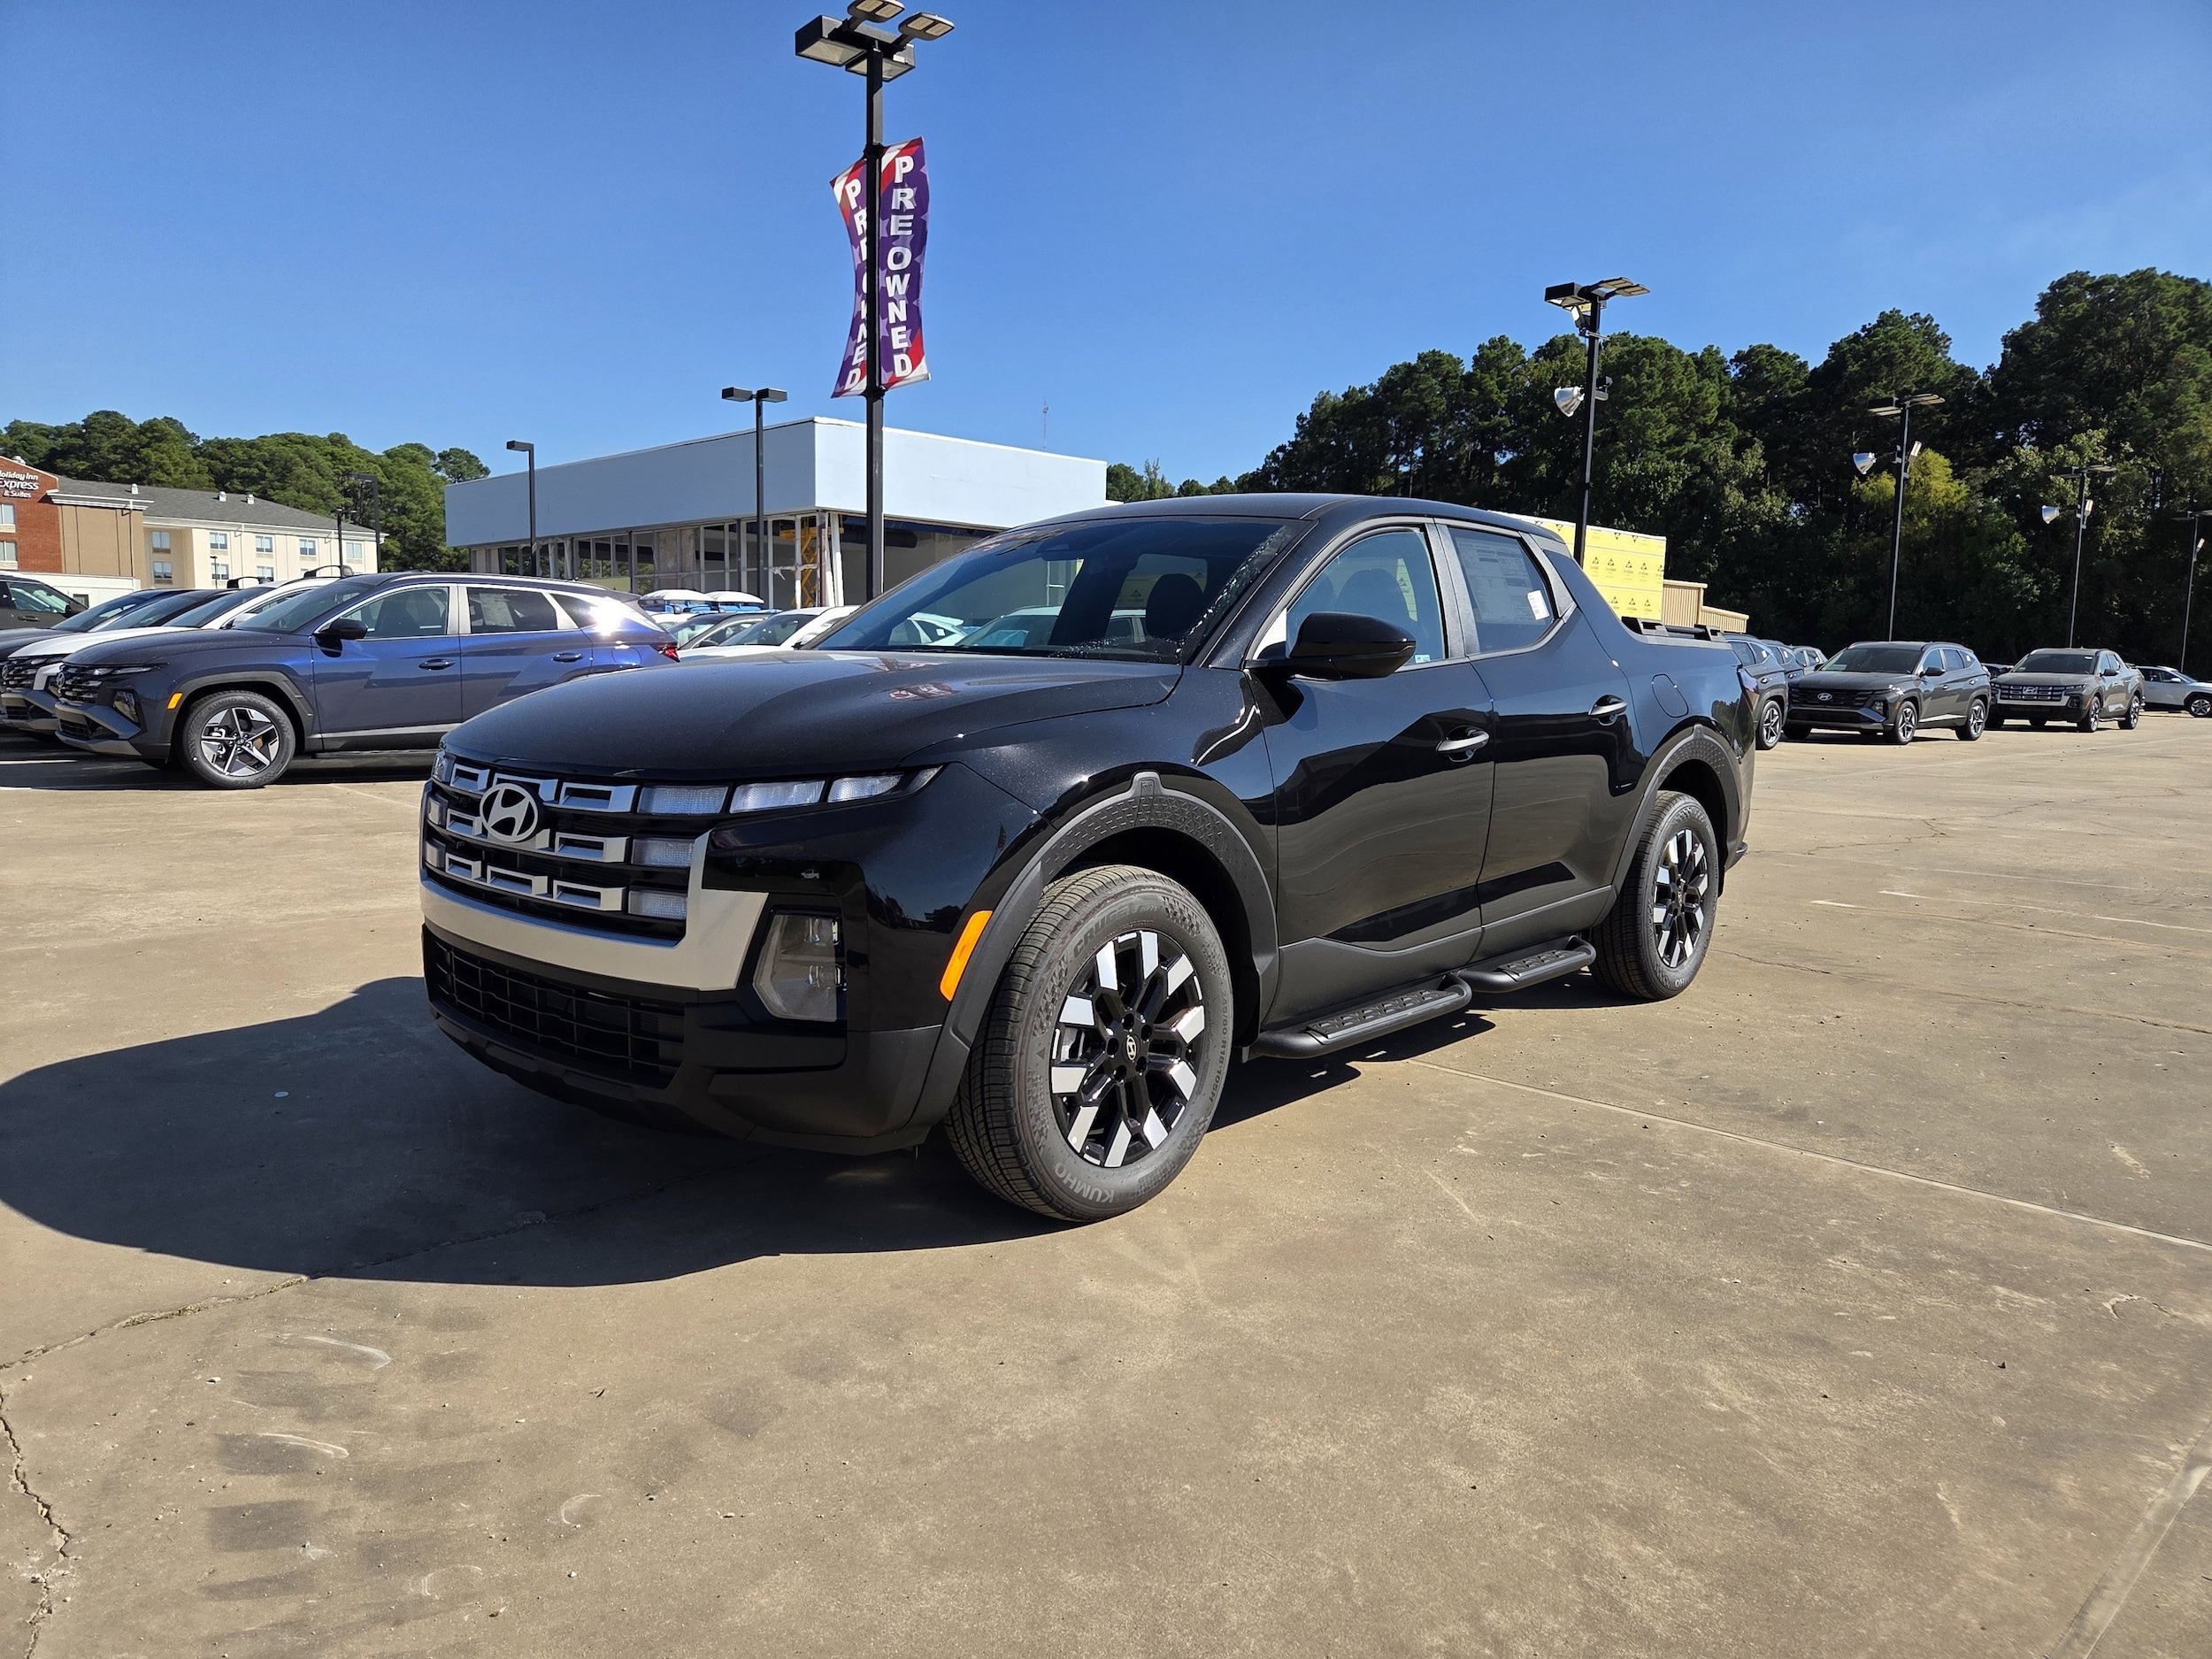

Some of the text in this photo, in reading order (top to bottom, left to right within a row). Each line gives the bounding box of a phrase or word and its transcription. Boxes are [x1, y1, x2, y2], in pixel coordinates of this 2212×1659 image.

[26, 472, 39, 480] Inn
[0, 478, 40, 490] Express
[1054, 1161, 1115, 1203] KUMHO
